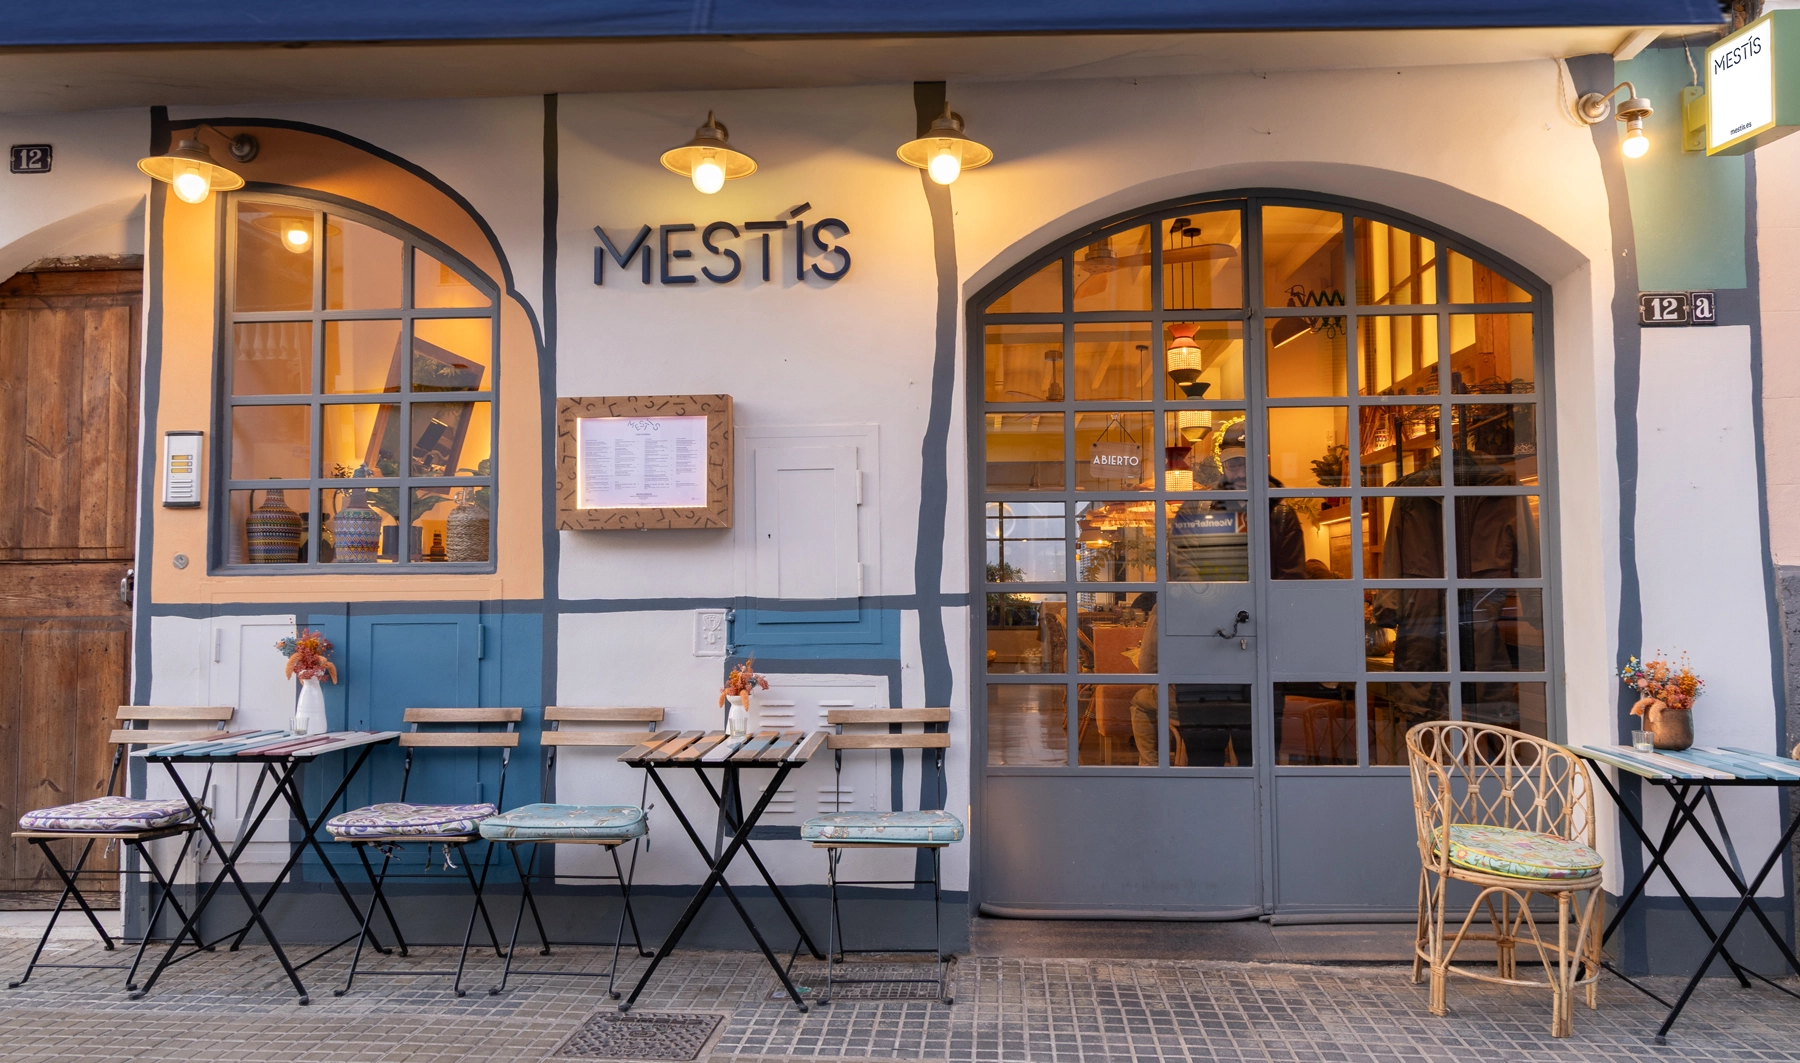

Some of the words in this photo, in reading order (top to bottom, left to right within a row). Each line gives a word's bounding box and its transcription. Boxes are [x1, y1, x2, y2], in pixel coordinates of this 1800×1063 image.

[1714, 36, 1762, 75] MESTÍS
[20, 149, 42, 169] 12
[594, 201, 851, 285] MESTÍS
[1651, 298, 1678, 320] 12
[1696, 297, 1713, 318] a
[1093, 455, 1139, 466] ABIERTO
